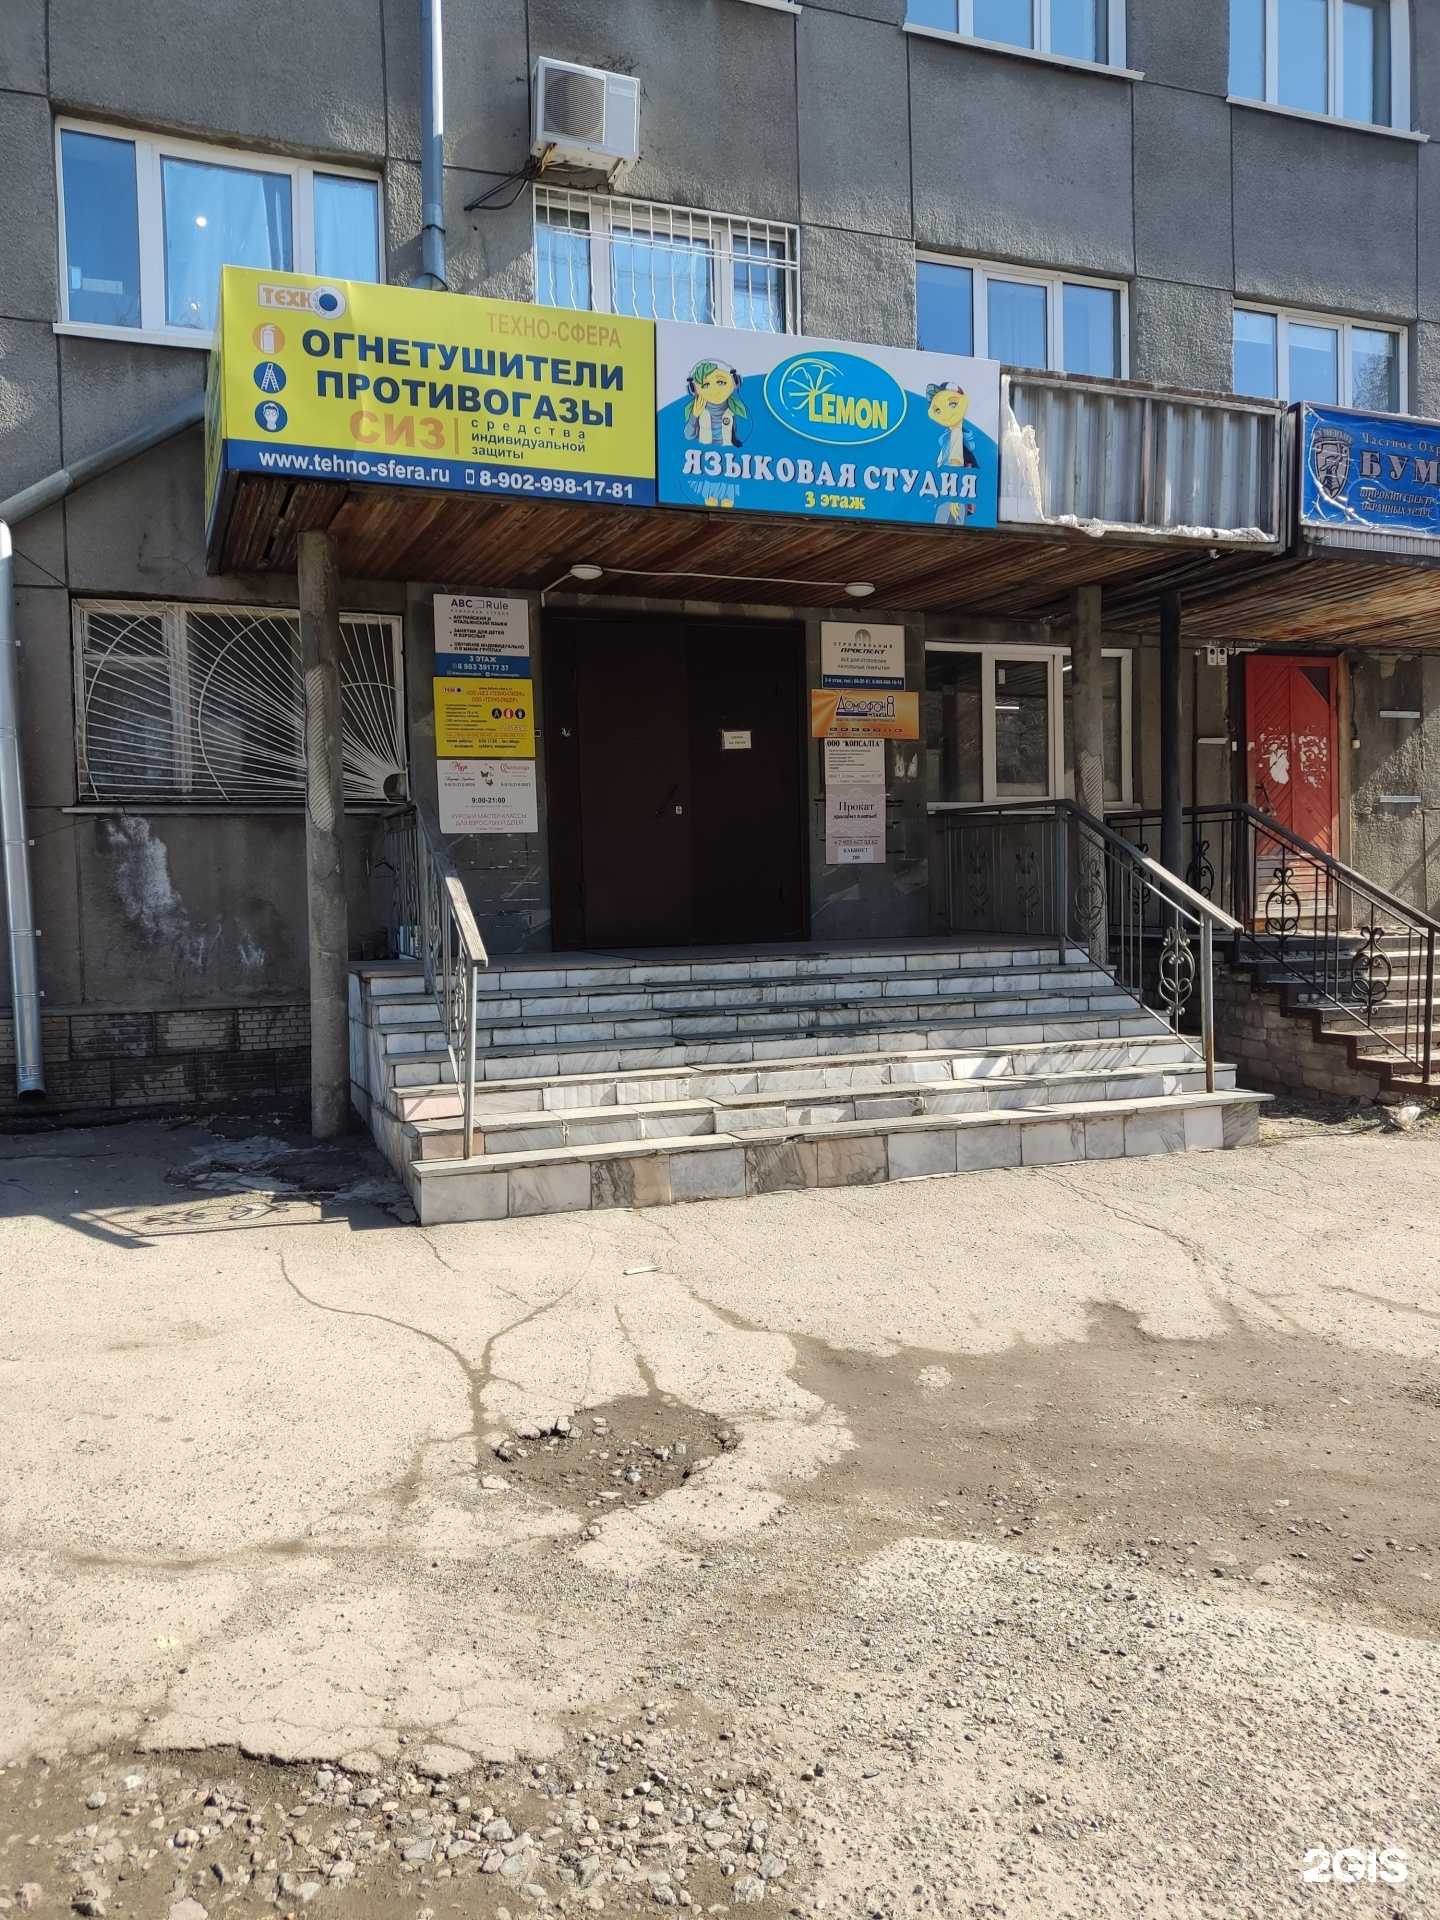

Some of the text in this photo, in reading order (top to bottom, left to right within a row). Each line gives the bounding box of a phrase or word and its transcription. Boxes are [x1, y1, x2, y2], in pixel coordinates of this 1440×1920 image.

[487, 312, 622, 349] ТЕХНО-СФЕРА
[302, 329, 624, 391] ОГНЕТУШИТЕЛИ
[316, 370, 614, 427] ПРОТИВОГАЗЫ
[808, 389, 888, 430] LEMON
[349, 411, 447, 451] СИЗ
[471, 418, 586, 439] средства
[471, 431, 586, 453] индивидуальной
[259, 451, 450, 484] www.tehno-sfera.ru
[471, 446, 524, 460] защиты
[480, 469, 634, 499] 8-902-998-17-81
[682, 449, 978, 498] ЯЗЫКОВАЯ СТУДИЯ
[805, 490, 867, 511] 3 этаж
[451, 599, 509, 610] ABC Rule
